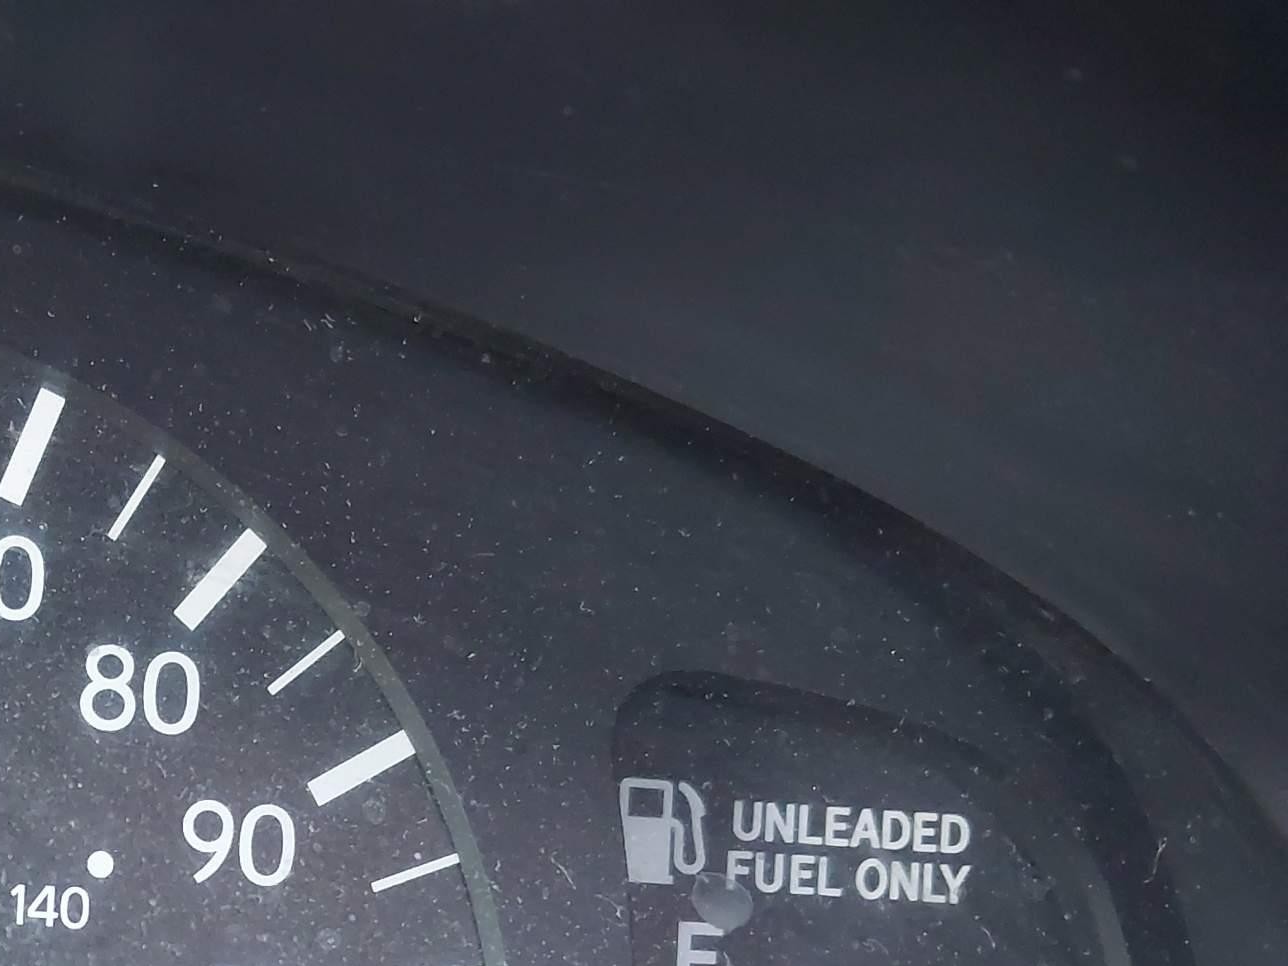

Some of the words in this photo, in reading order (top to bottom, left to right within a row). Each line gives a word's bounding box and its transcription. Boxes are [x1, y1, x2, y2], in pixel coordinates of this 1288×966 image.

[80, 644, 200, 734] 80
[183, 800, 295, 886] 90
[731, 800, 970, 855] UNLEADED
[725, 850, 842, 897] FUEL
[854, 857, 971, 905] ONLY
[11, 884, 89, 929] 140
